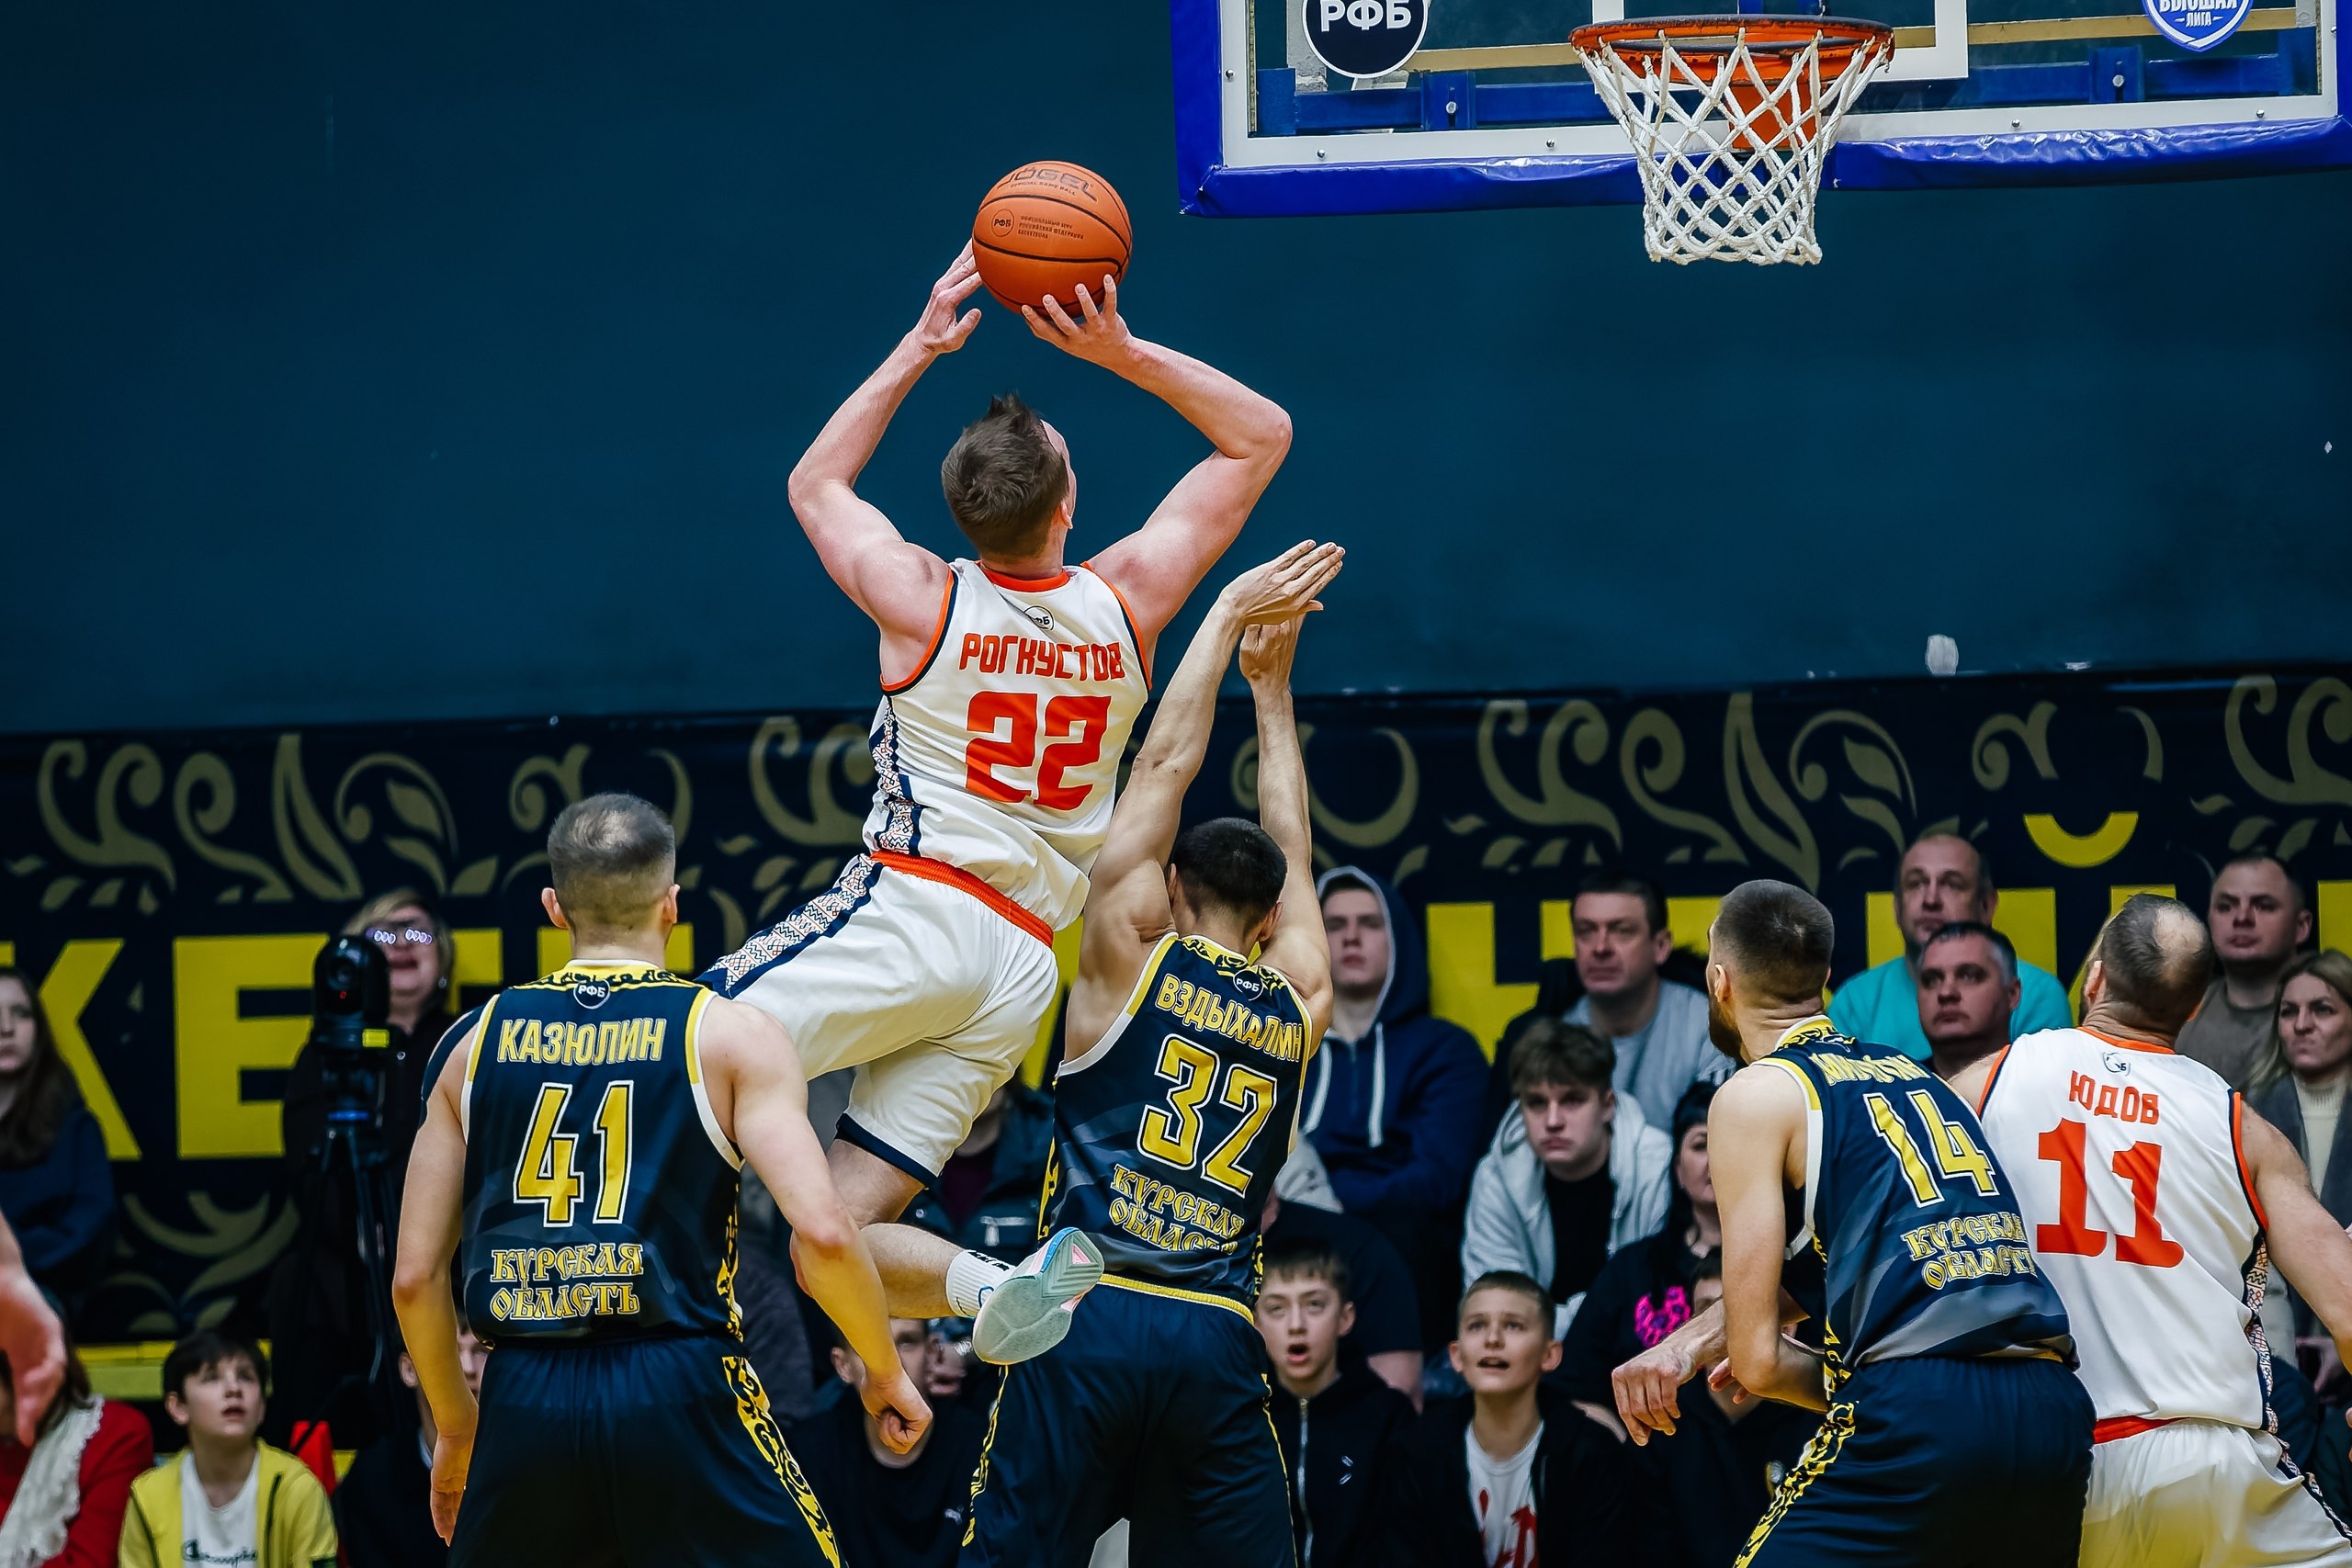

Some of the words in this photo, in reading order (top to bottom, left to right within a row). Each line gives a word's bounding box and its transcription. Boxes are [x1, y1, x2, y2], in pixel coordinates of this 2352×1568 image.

[1320, 0, 1412, 32] РФБ
[2186, 11, 2212, 28] ЛИГА
[993, 219, 1012, 228] РФБ
[958, 632, 1125, 682] РОГКУСТОВ
[966, 690, 1112, 811] 22
[577, 985, 606, 998] РФБ
[1236, 979, 1261, 992] РФБ
[497, 1018, 667, 1066] КАЗЮЛИН
[1136, 1033, 1278, 1198] 32
[2069, 1069, 2159, 1125] ЮДОВ
[513, 1079, 634, 1227] 41
[1862, 1089, 2000, 1209] 14
[1110, 1163, 1246, 1240] КУРСКАЯ
[2036, 1117, 2185, 1269] 11
[491, 1242, 644, 1290] КУРСКАЯ
[490, 1282, 640, 1322] ОБЛАСТЬ
